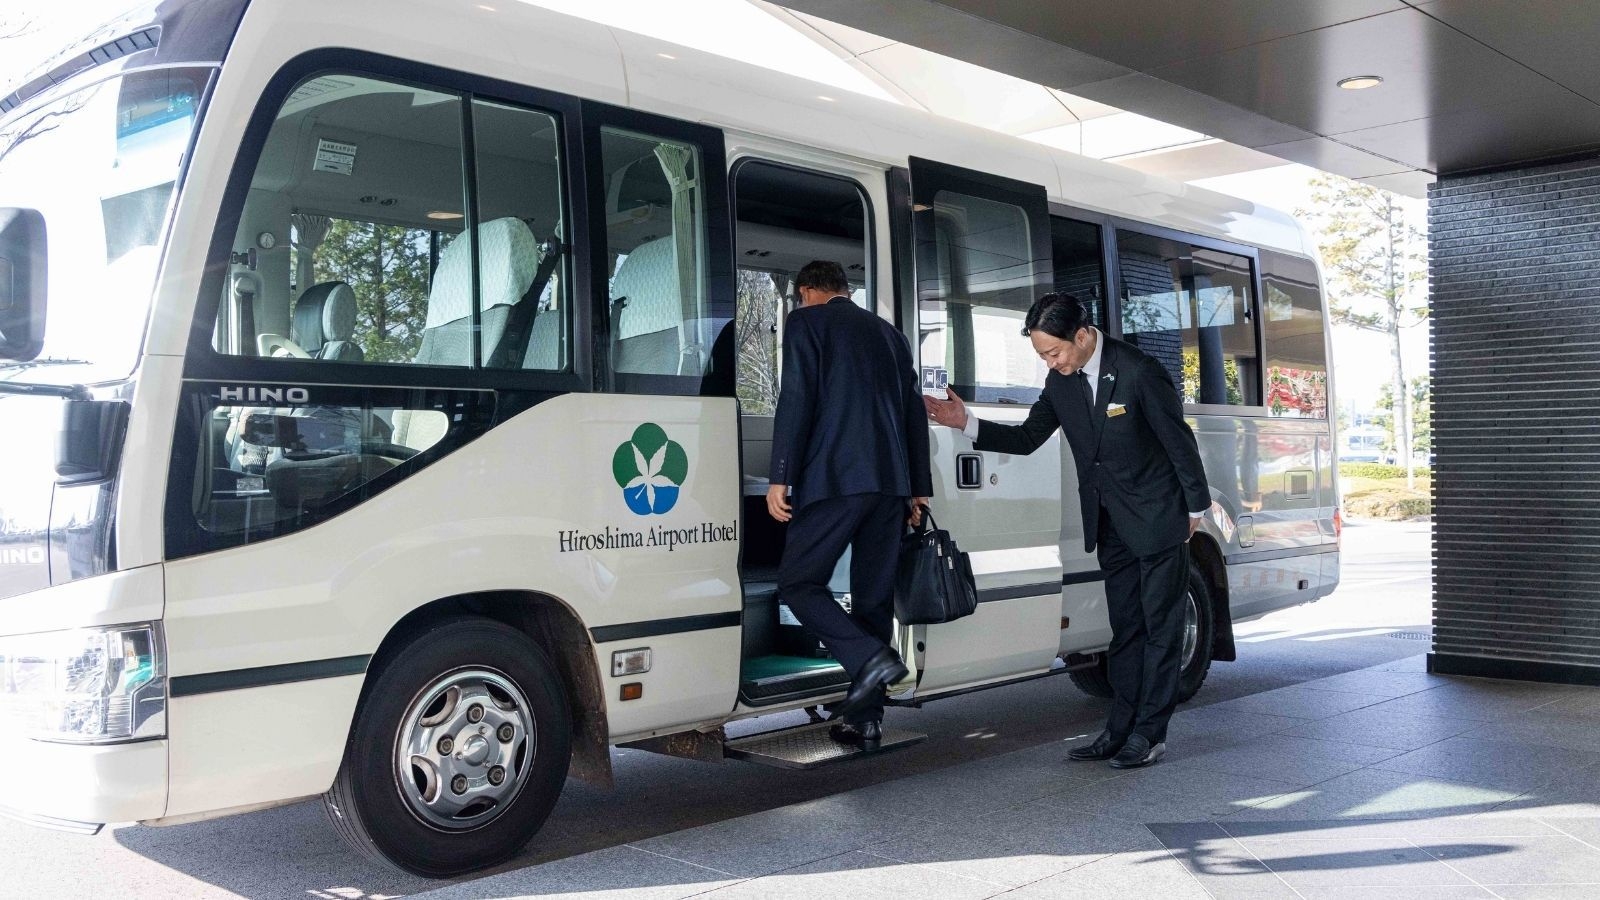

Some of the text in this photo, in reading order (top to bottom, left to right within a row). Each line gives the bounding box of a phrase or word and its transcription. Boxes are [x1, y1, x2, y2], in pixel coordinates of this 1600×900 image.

[220, 386, 309, 403] HINO
[559, 520, 738, 552] Hiroshima Airport Hotel
[0, 546, 45, 564] INO
